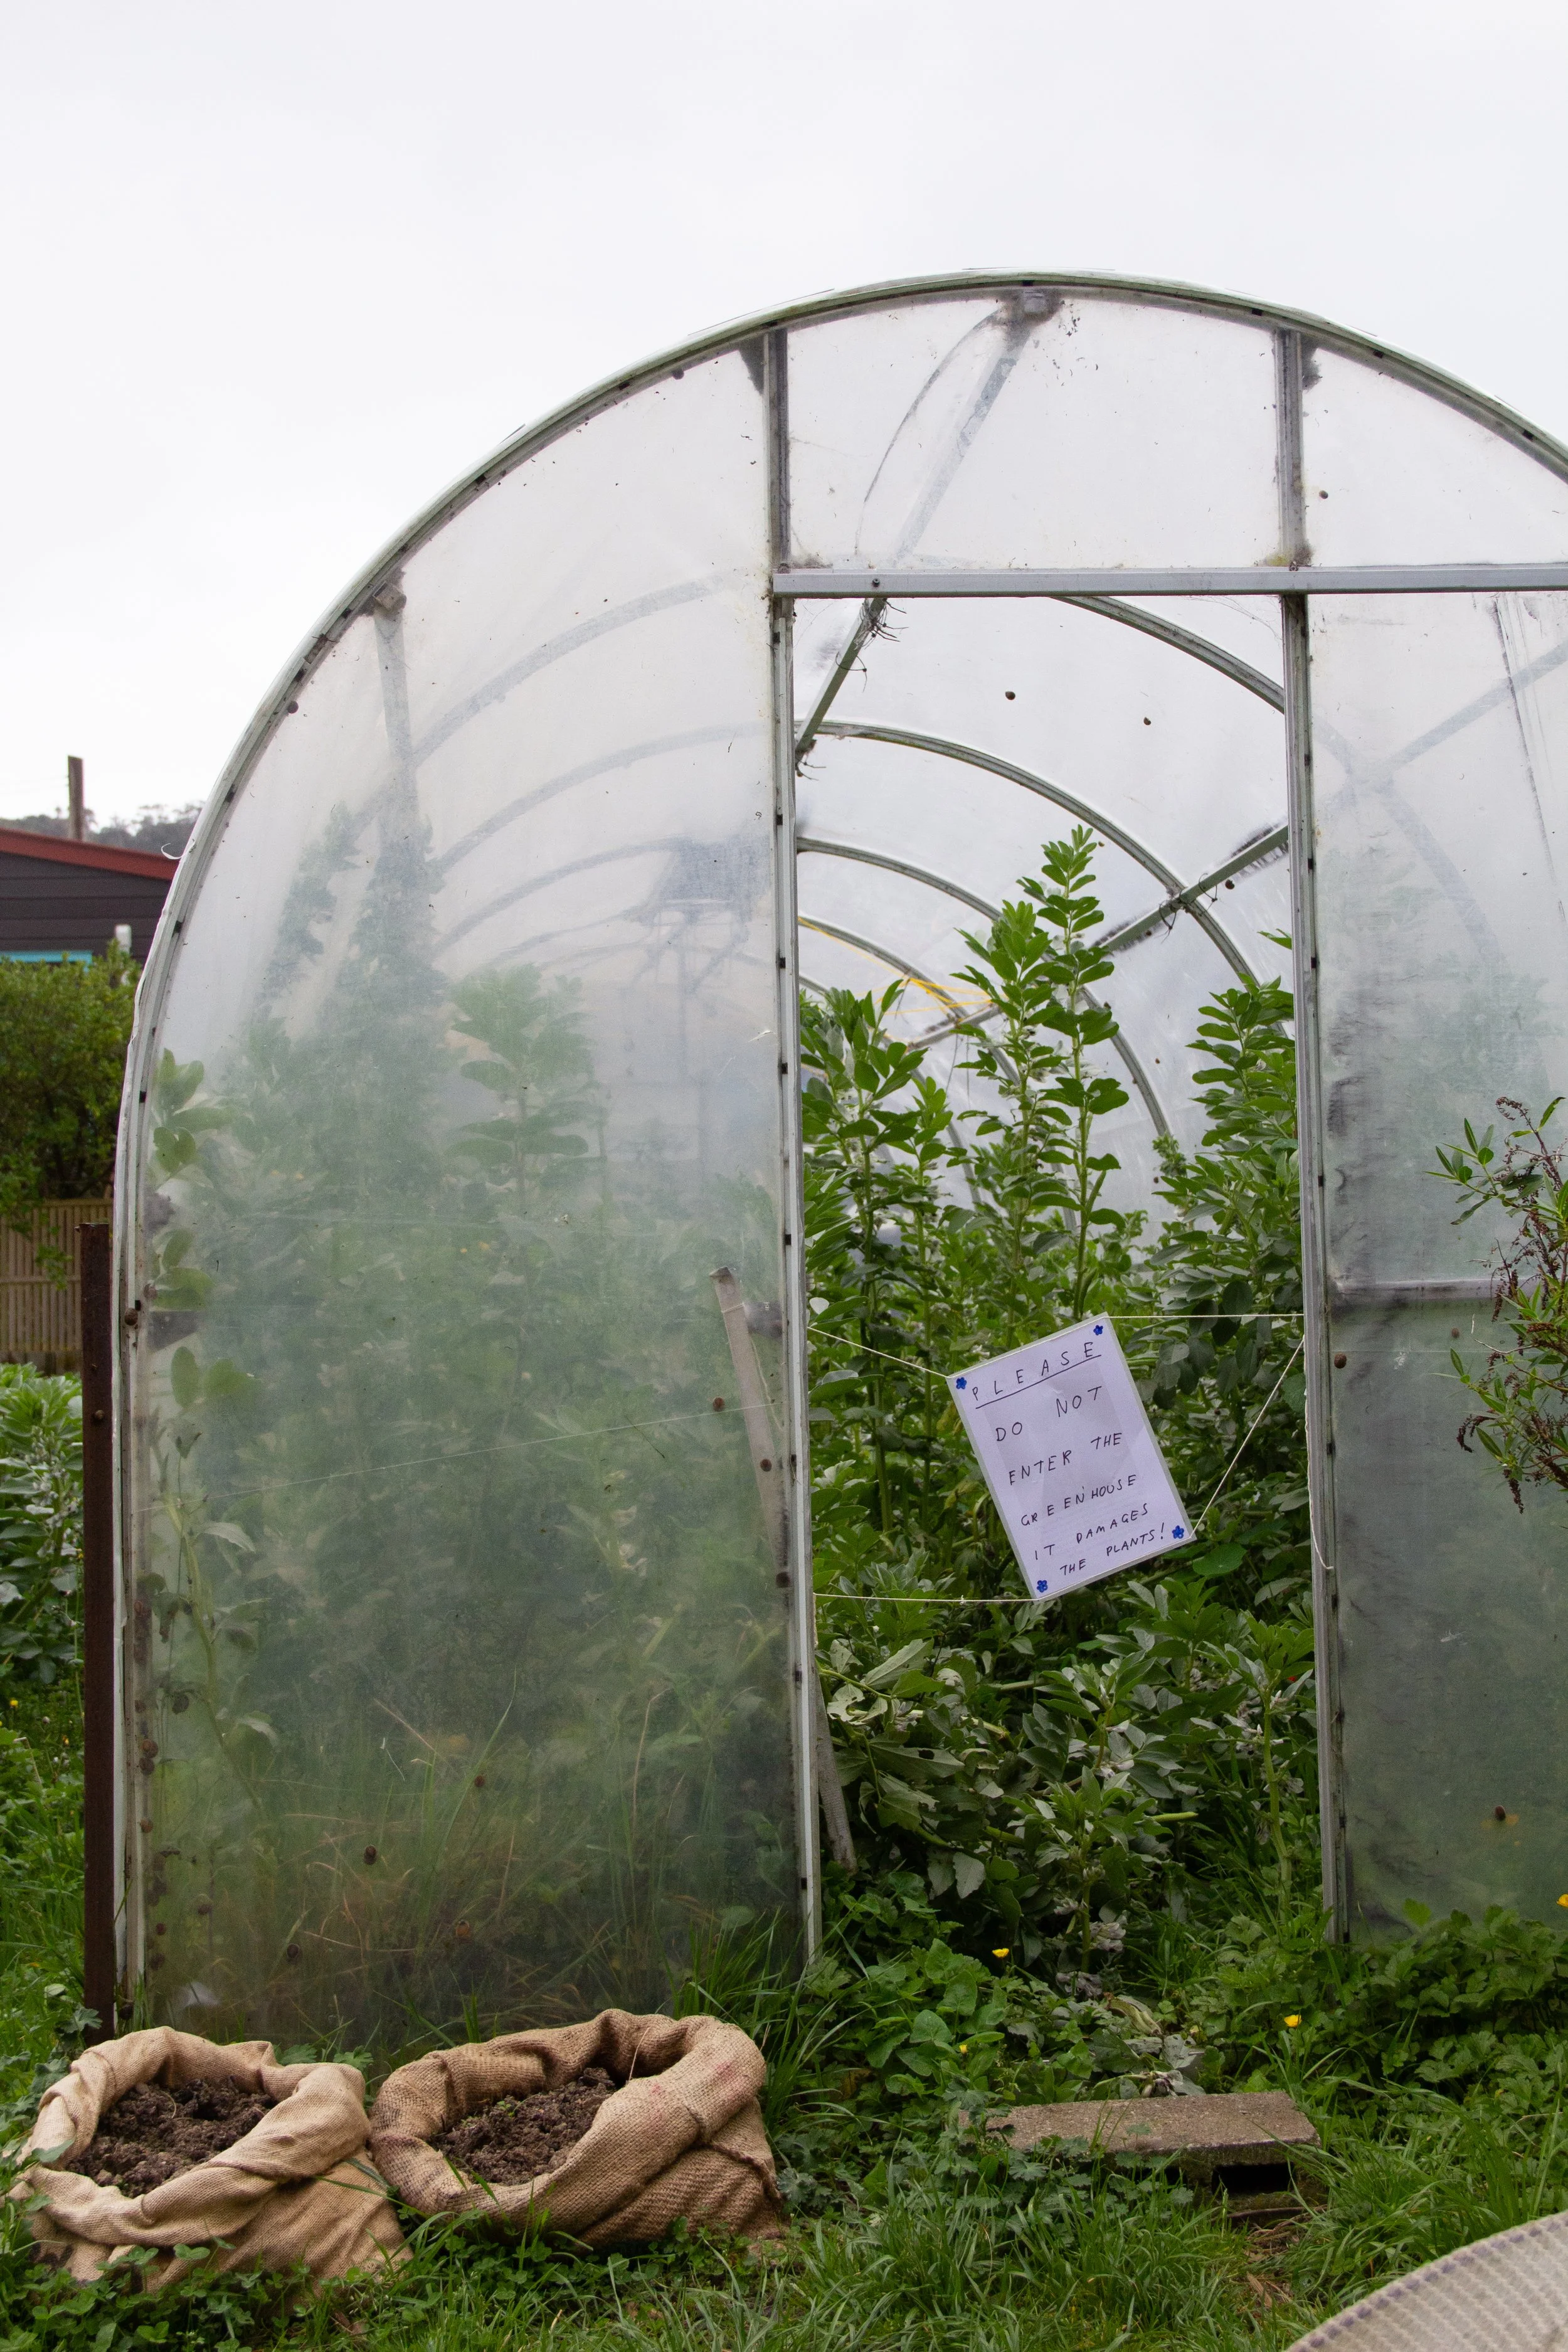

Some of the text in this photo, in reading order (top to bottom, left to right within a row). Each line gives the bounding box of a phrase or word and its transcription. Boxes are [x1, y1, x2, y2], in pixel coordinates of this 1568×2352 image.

[972, 1341, 1094, 1401] PLEASE
[996, 1386, 1102, 1442] DO NOT
[1009, 1433, 1122, 1485] ENTER THE
[1021, 1474, 1136, 1526] GREENHOUSE
[1035, 1503, 1148, 1560] IT DAMAGES
[1060, 1522, 1165, 1576] THE PLANTS!
